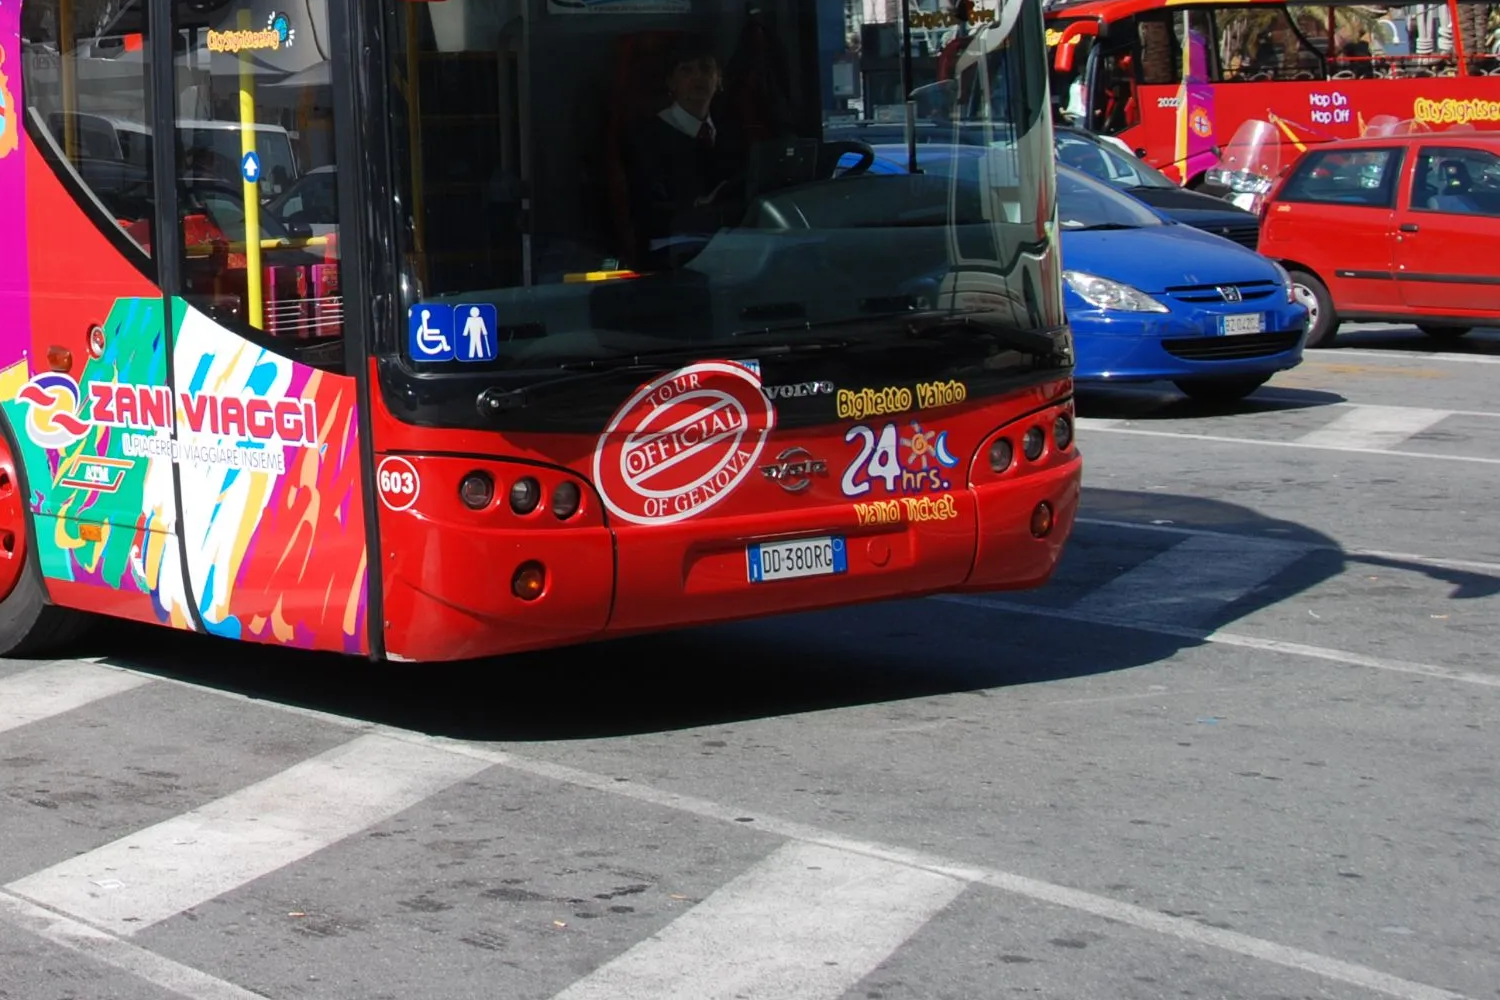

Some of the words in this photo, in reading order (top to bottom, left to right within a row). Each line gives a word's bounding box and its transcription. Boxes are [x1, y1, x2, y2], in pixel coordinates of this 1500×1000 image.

[207, 28, 280, 53] CitySightseeing
[1309, 93, 1331, 108] Hop
[1332, 91, 1347, 105] On
[1311, 110, 1332, 124] Hop
[1333, 108, 1350, 123] Off
[1414, 97, 1500, 125] CitySightse
[645, 373, 702, 410] TOUR
[762, 380, 835, 400] VOLVO
[837, 386, 912, 420] Biglietto
[916, 379, 967, 409] Valido
[91, 384, 172, 428] ZANI
[181, 392, 316, 444] VIAGGI
[123, 434, 133, 452] IL
[133, 435, 171, 455] PIACERE
[172, 439, 182, 460] DI
[183, 443, 239, 466] VIAGGIARE
[240, 451, 284, 471] INSIEME
[626, 403, 741, 475] OFFICIAL
[841, 423, 901, 496] 24
[380, 470, 415, 494] 603
[643, 498, 669, 517] OF
[674, 449, 752, 514] GENOVA
[853, 500, 901, 526] Valid
[901, 494, 958, 522] Ticket
